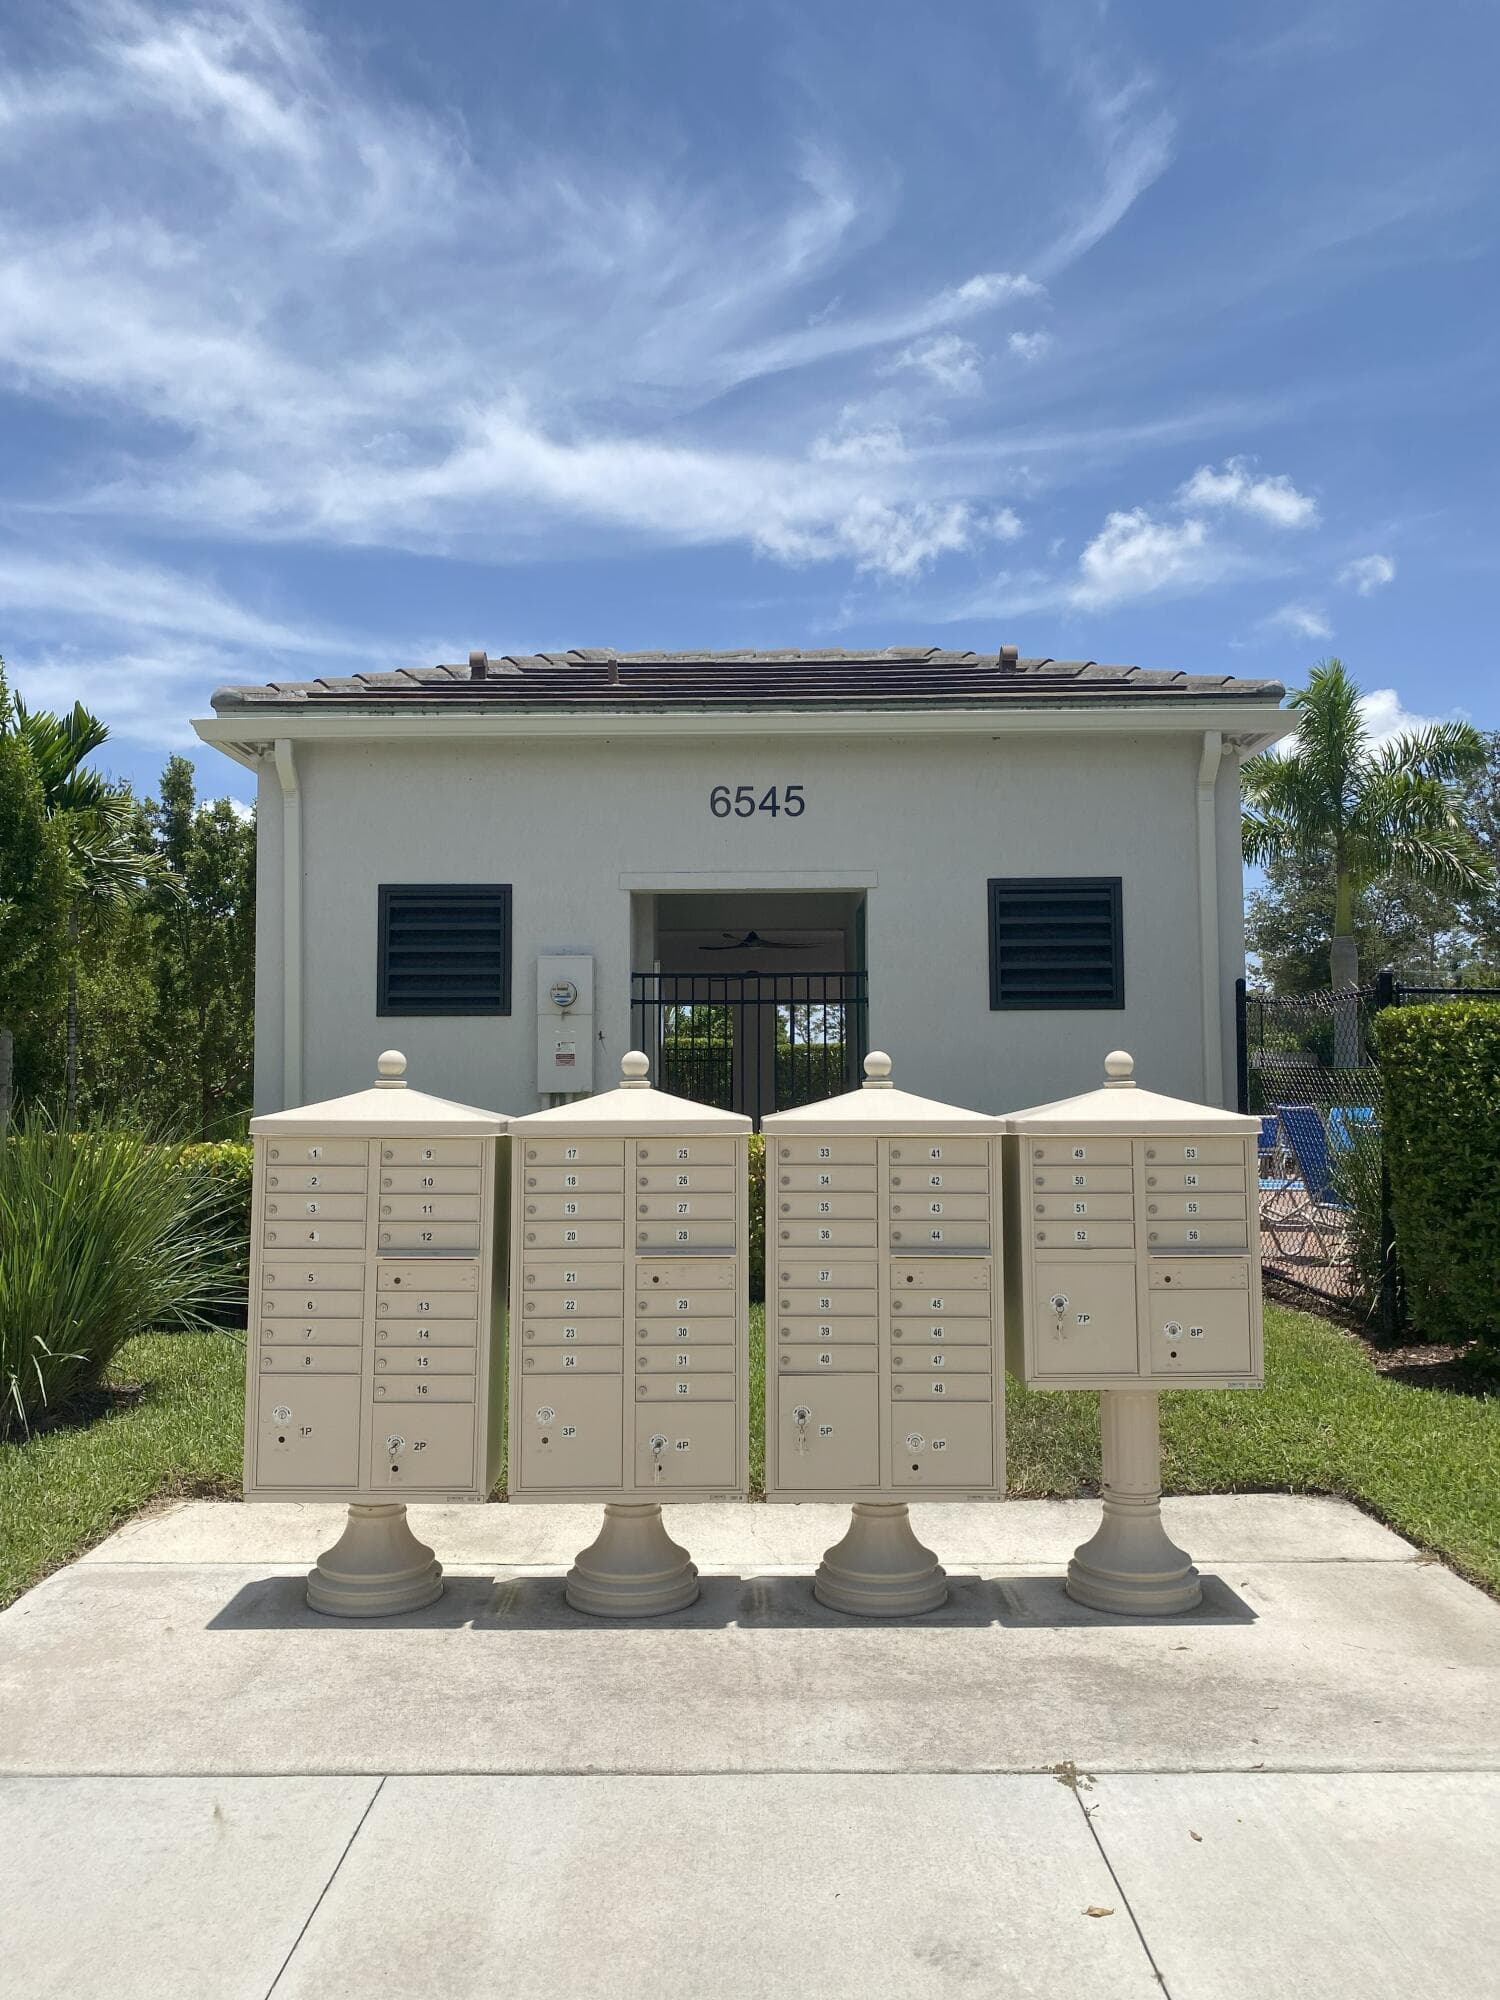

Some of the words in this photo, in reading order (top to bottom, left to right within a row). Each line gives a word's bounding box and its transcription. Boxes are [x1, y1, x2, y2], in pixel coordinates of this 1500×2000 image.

[710, 786, 805, 818] 6545
[426, 1150, 432, 1158] 9
[568, 1150, 576, 1158] 17
[679, 1150, 688, 1158] 25
[820, 1148, 830, 1157] 33
[1074, 1149, 1083, 1158] 49
[1186, 1149, 1195, 1158] 53
[312, 1177, 317, 1185] 2
[568, 1177, 576, 1186] 18
[679, 1176, 688, 1185] 26
[821, 1176, 829, 1184] 34
[931, 1176, 940, 1185] 42
[1075, 1176, 1084, 1184] 50
[1187, 1176, 1196, 1184] 54
[310, 1204, 316, 1213] 3
[567, 1204, 576, 1213] 19
[678, 1204, 687, 1212] 27
[821, 1202, 829, 1212] 35
[932, 1204, 940, 1212] 43
[1076, 1204, 1084, 1212] 51
[1188, 1204, 1197, 1212] 55
[422, 1233, 432, 1241] 12
[567, 1232, 576, 1240] 20
[678, 1231, 688, 1240] 28
[821, 1230, 830, 1239] 36
[1077, 1232, 1086, 1240] 52
[1189, 1231, 1198, 1240] 56
[308, 1274, 314, 1282] 5
[566, 1273, 575, 1282] 21
[821, 1272, 829, 1280] 37
[307, 1301, 313, 1310] 6
[419, 1302, 430, 1310] 13
[566, 1301, 574, 1310] 22
[679, 1300, 688, 1309] 29
[821, 1299, 829, 1308] 38
[932, 1300, 942, 1308] 45
[306, 1329, 312, 1337] 7
[566, 1329, 574, 1338] 23
[678, 1328, 687, 1336] 30
[821, 1327, 830, 1336] 39
[934, 1328, 942, 1336] 46
[1190, 1328, 1203, 1336] 8P
[305, 1356, 311, 1365] 8
[418, 1358, 428, 1366] 15
[566, 1357, 574, 1366] 24
[679, 1356, 686, 1364] 31
[820, 1355, 830, 1364] 40
[934, 1356, 942, 1364] 47
[417, 1386, 428, 1394] 16
[679, 1384, 687, 1393] 32
[934, 1384, 943, 1392] 48
[301, 1427, 312, 1435] 1P
[563, 1428, 575, 1436] 3P
[414, 1442, 426, 1450] 2P
[933, 1441, 946, 1449] 6P
